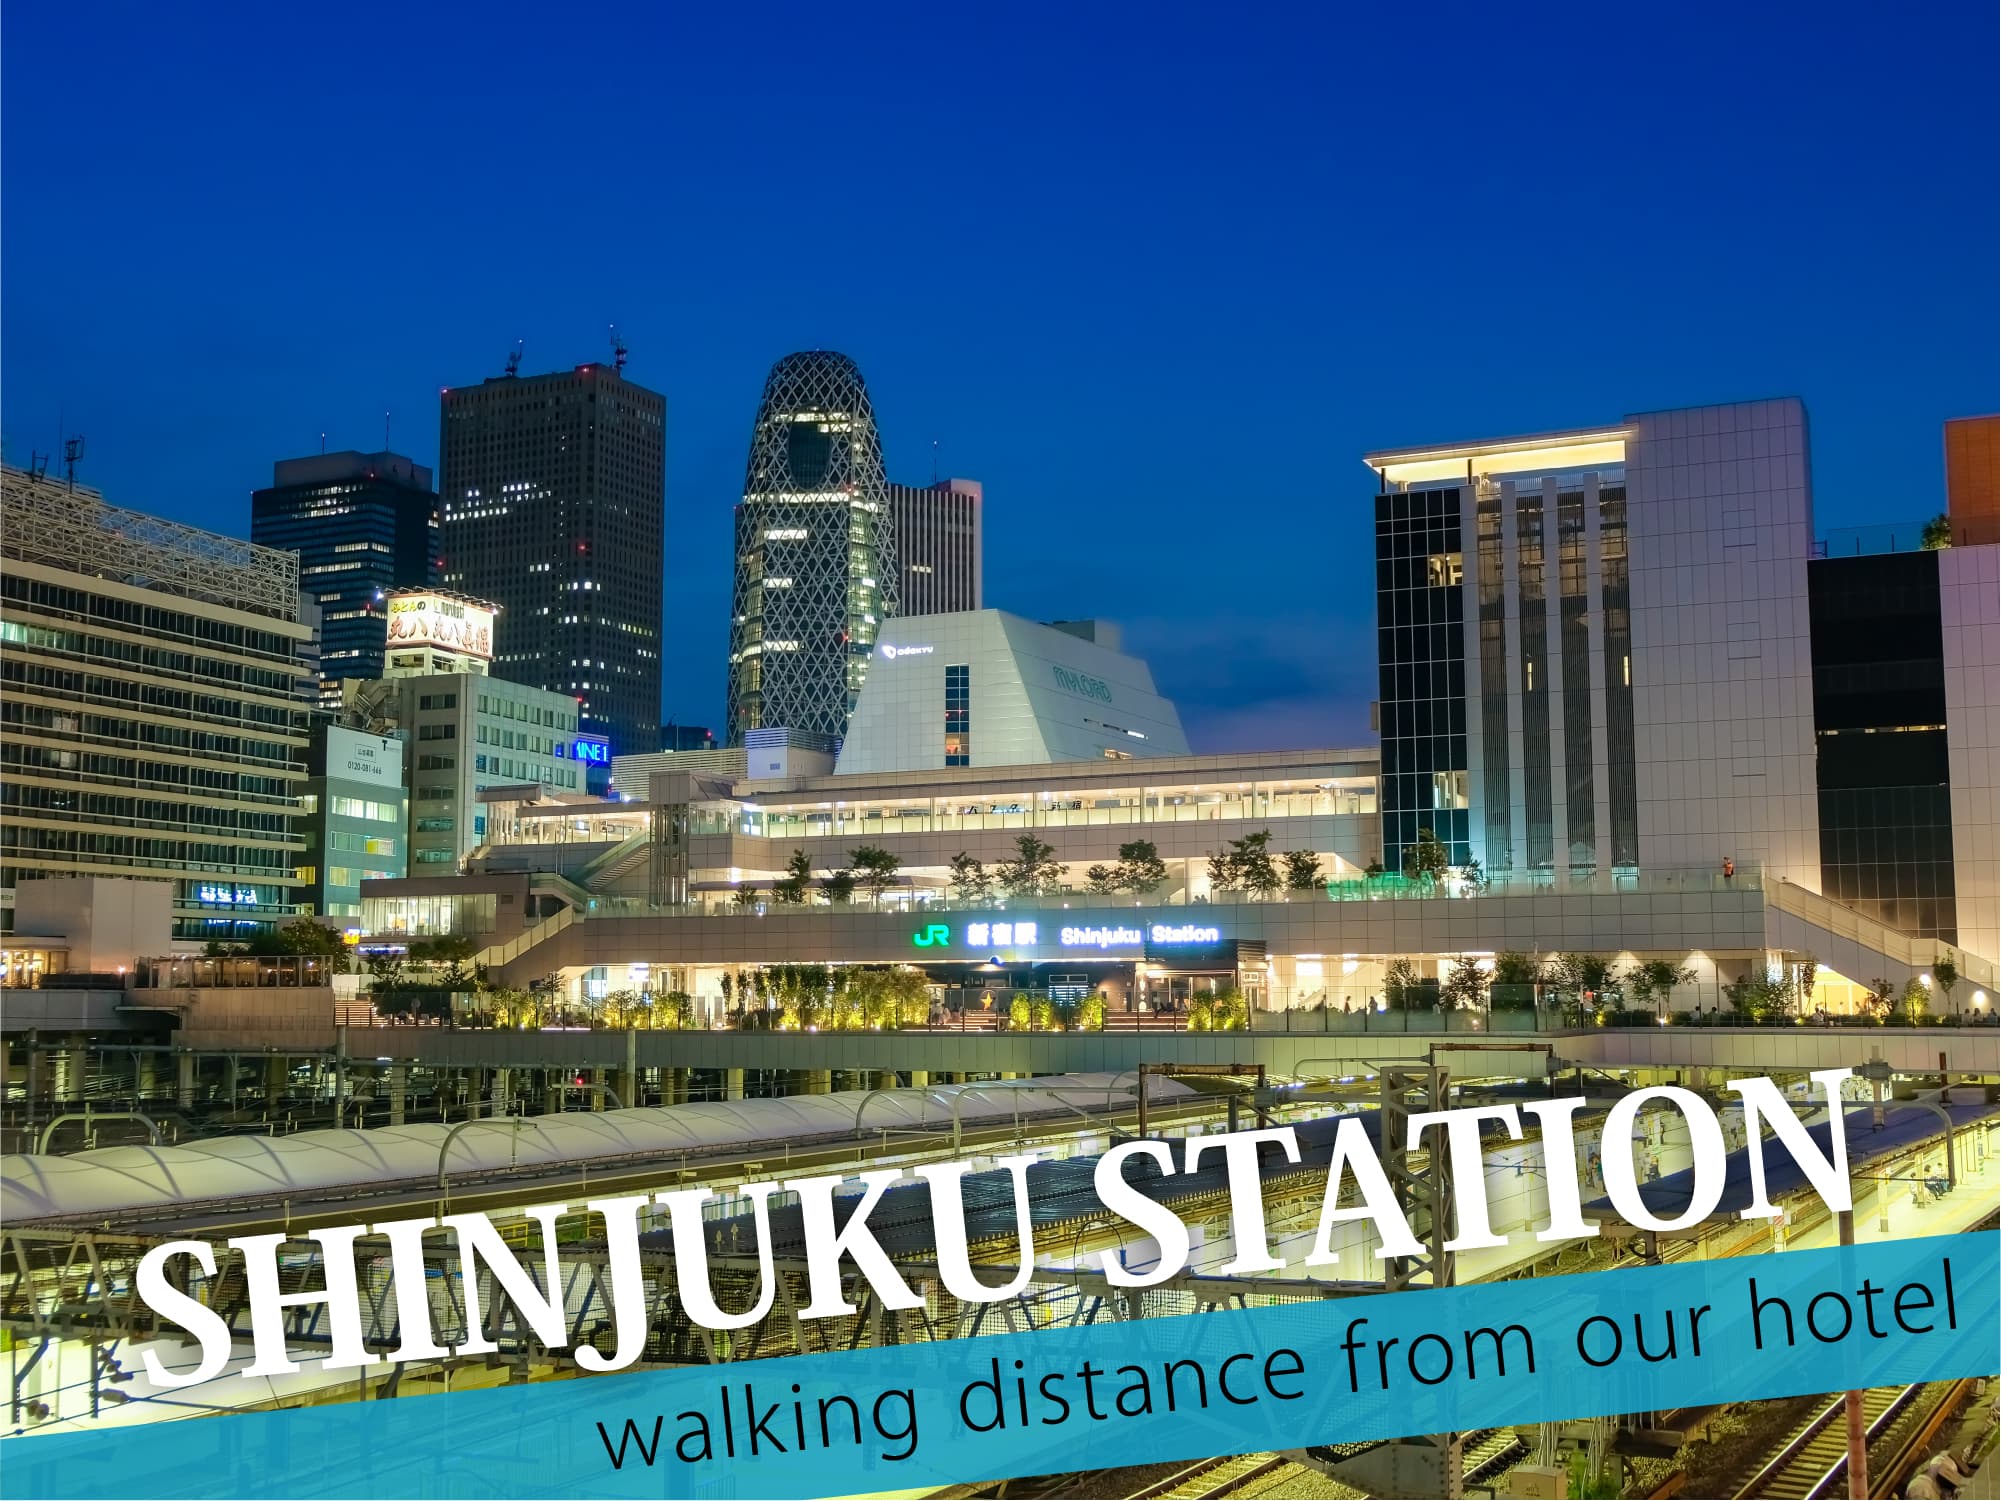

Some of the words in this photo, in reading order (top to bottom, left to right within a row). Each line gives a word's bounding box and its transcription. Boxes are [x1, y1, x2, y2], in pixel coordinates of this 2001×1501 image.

[913, 924, 950, 947] JR
[967, 922, 1037, 946] 新宿駅
[1061, 927, 1141, 948] Shinjuku
[1152, 925, 1218, 943] Station
